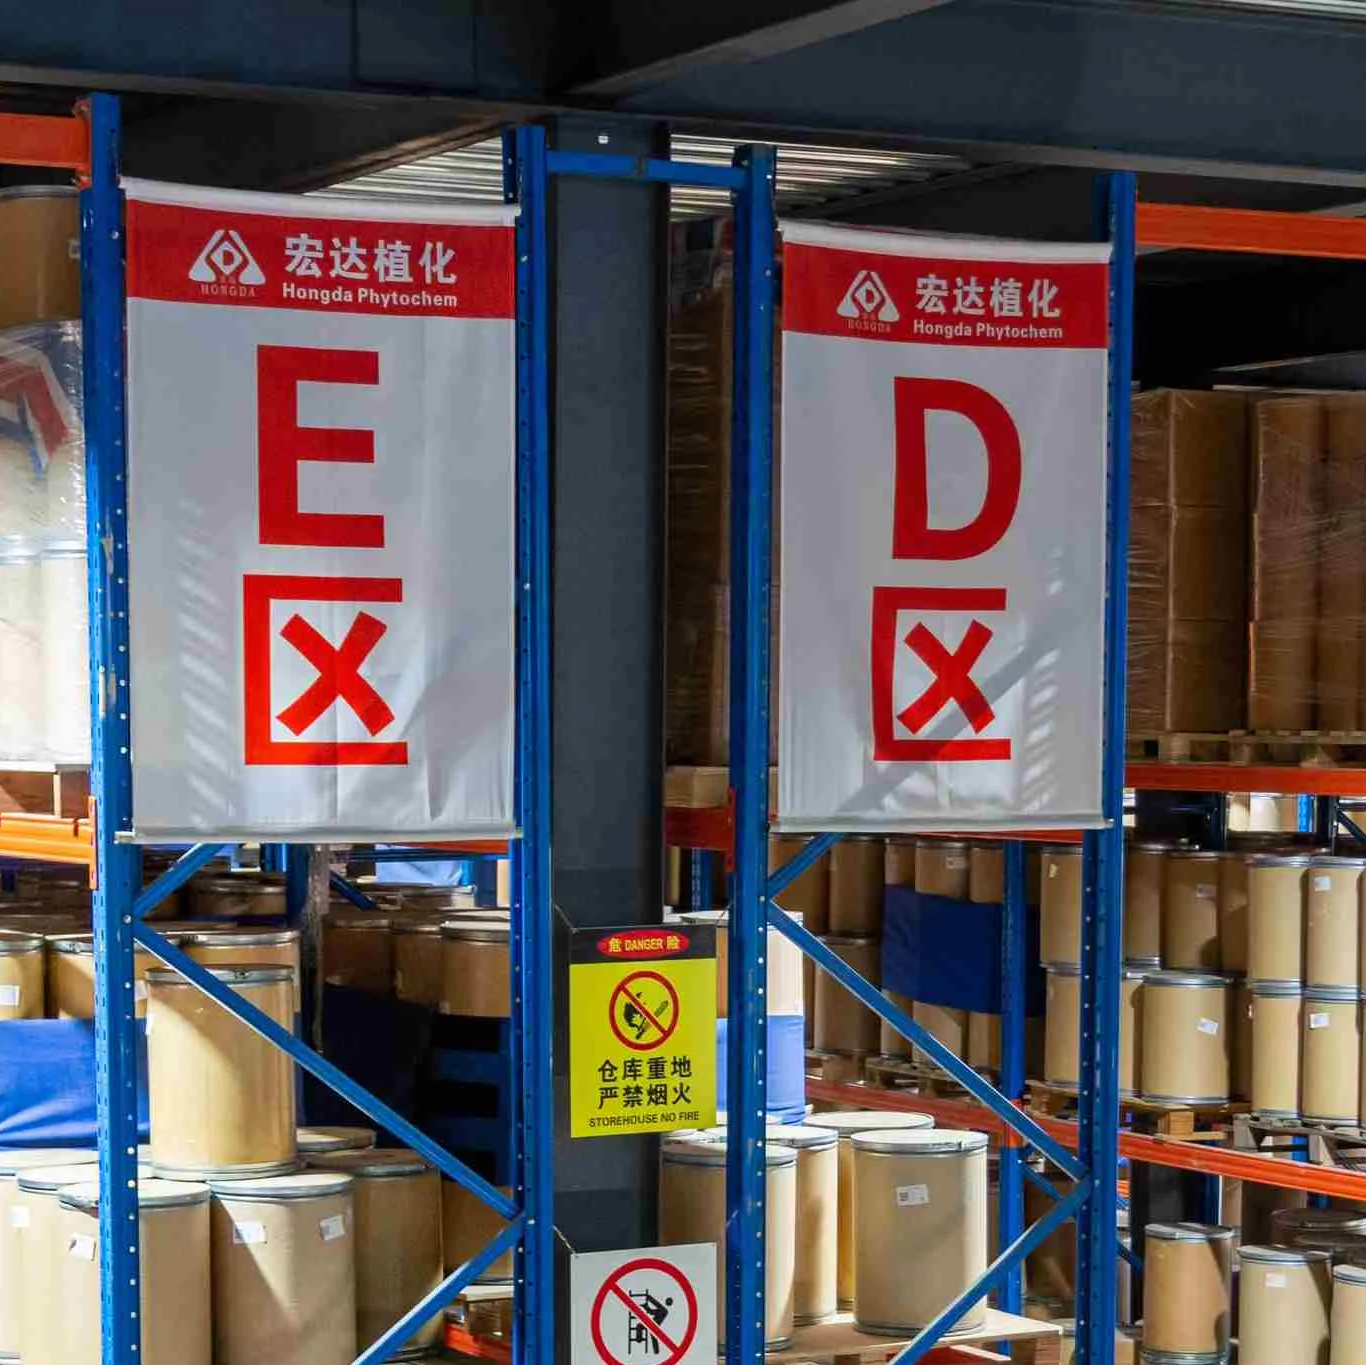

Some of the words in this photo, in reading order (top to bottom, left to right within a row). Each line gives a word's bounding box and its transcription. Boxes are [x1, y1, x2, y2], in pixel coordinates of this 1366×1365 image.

[284, 233, 458, 285] 宏达植化
[282, 282, 353, 305] Hongda
[357, 287, 458, 308] Phytochem
[915, 274, 1061, 318] 宏达植化
[913, 319, 972, 338] Hongda
[976, 323, 1063, 341] Phytochem
[257, 345, 385, 548] E
[892, 377, 1021, 561] D
[243, 574, 409, 766] 区
[871, 587, 1012, 762] 区
[624, 938, 663, 951] DANGER
[597, 1056, 692, 1083] 仓库重地
[598, 1082, 691, 1109] 严禁烟火
[588, 1113, 658, 1128] STOREHOUSE
[660, 1112, 676, 1123] NO
[679, 1111, 700, 1121] FIRE
